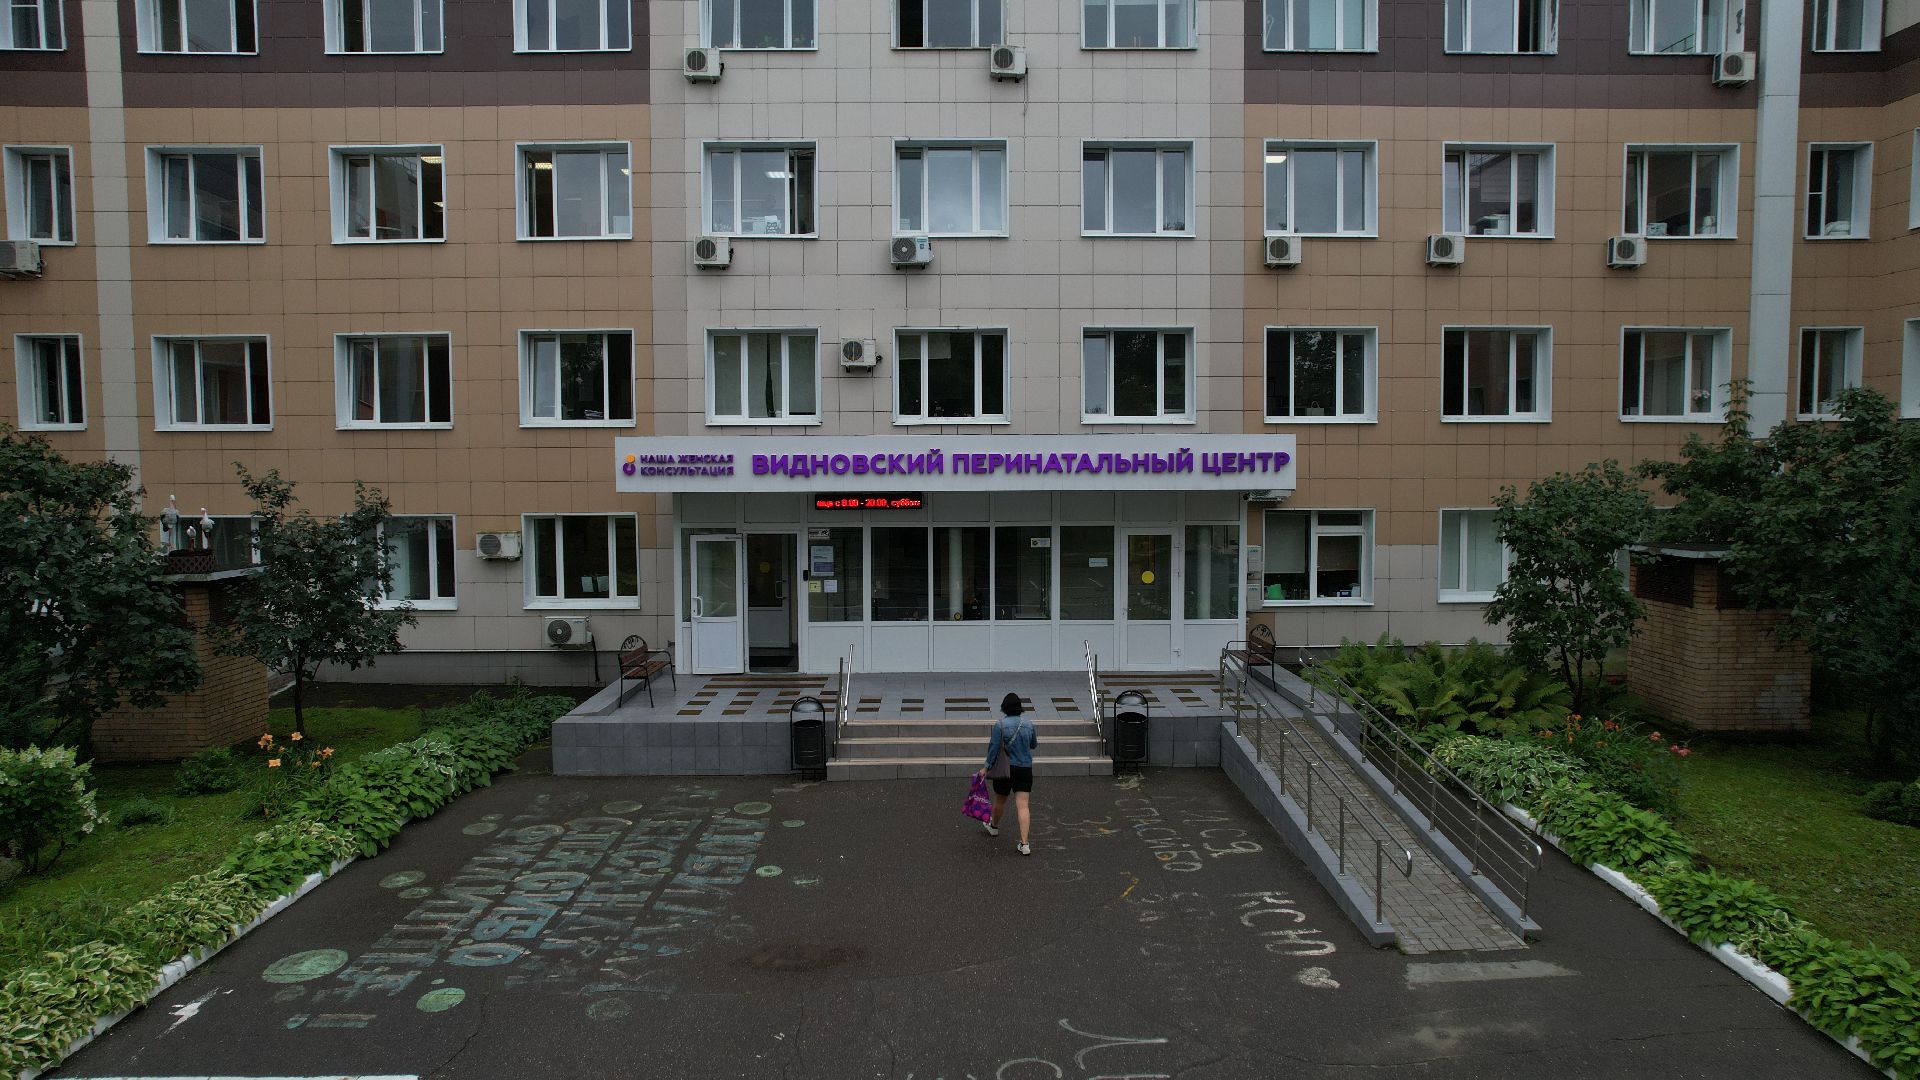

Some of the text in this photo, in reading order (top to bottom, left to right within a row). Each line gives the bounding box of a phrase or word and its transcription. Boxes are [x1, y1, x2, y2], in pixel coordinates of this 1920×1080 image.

[640, 454, 734, 465] НАША ЖЕНСКАЯ
[640, 465, 734, 477] КОНСУЛЬТАЦИЯ
[752, 447, 1291, 478] ВИДНОВСКИЙ ПЕРИНАТАЛЬНЫЙ ЦЕНТР
[1112, 798, 1206, 872] СПАСИБО
[438, 816, 635, 967] СПАСИБО
